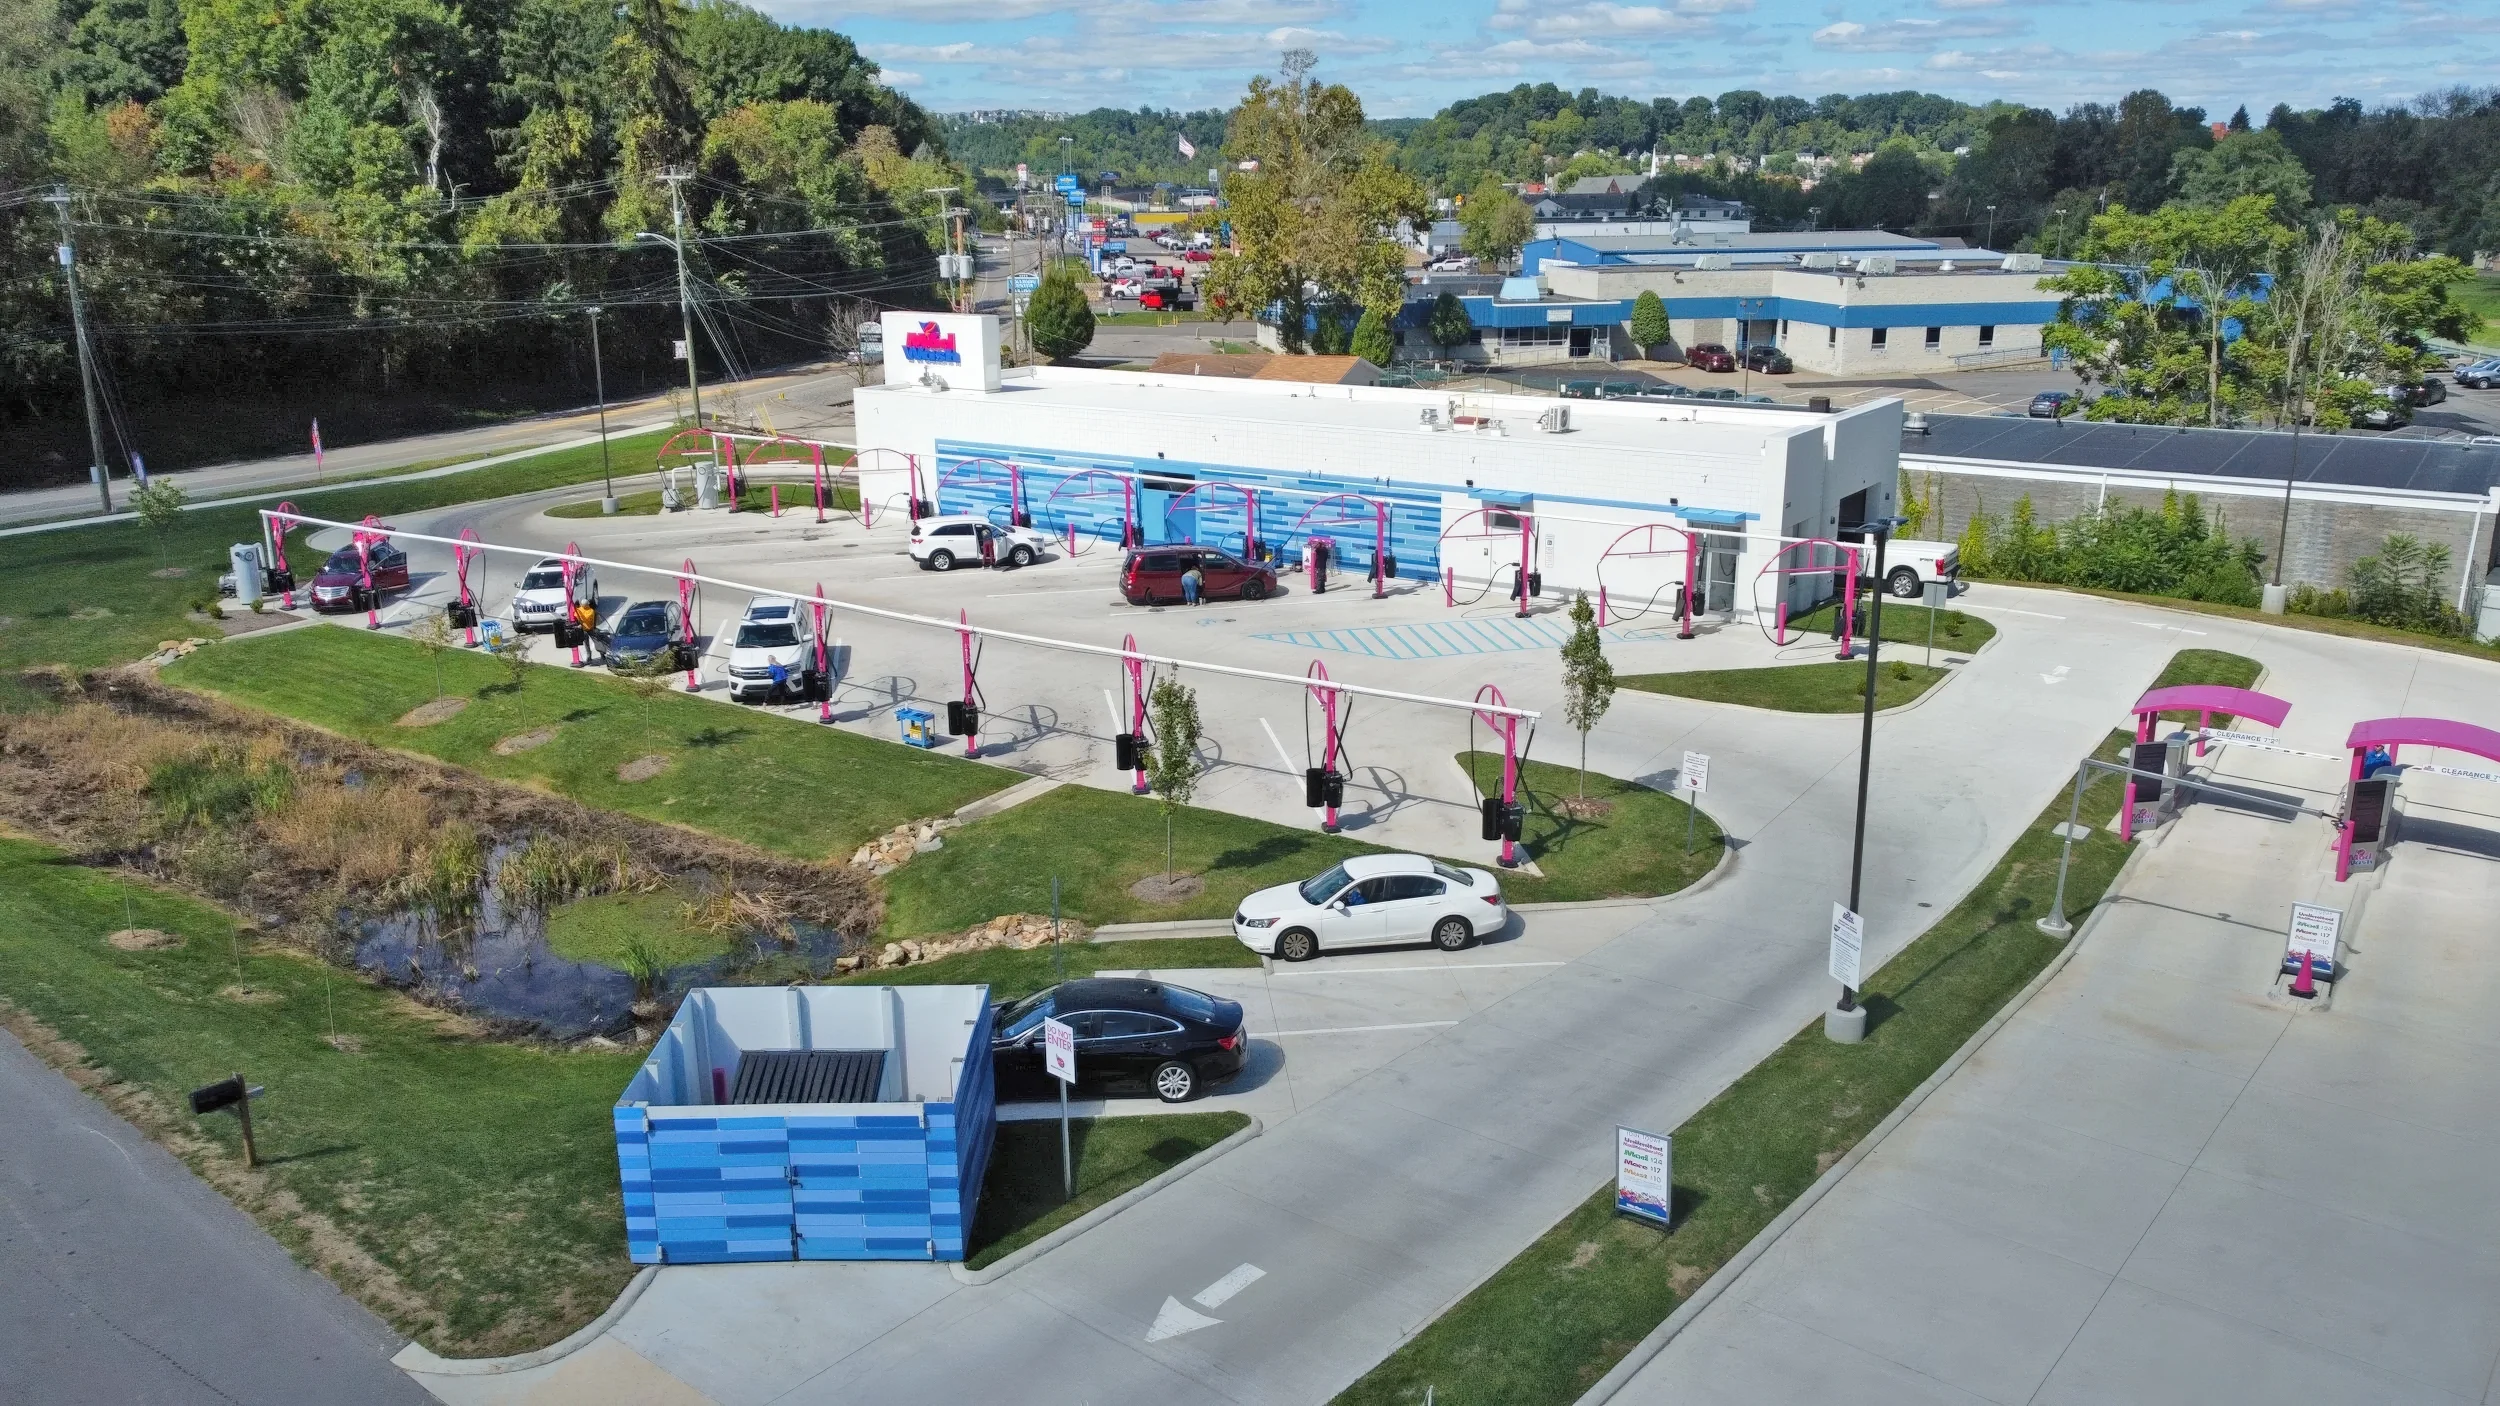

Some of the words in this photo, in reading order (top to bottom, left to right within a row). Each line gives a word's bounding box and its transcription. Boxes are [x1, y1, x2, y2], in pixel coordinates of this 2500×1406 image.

[2216, 730, 2261, 742] CLEARANCE
[2441, 767, 2490, 780] CLEARANCE
[1047, 1024, 1056, 1034] DO
[1058, 1029, 1071, 1041] NOT
[1047, 1033, 1072, 1052] ENTER
[1624, 1158, 1648, 1170] More
